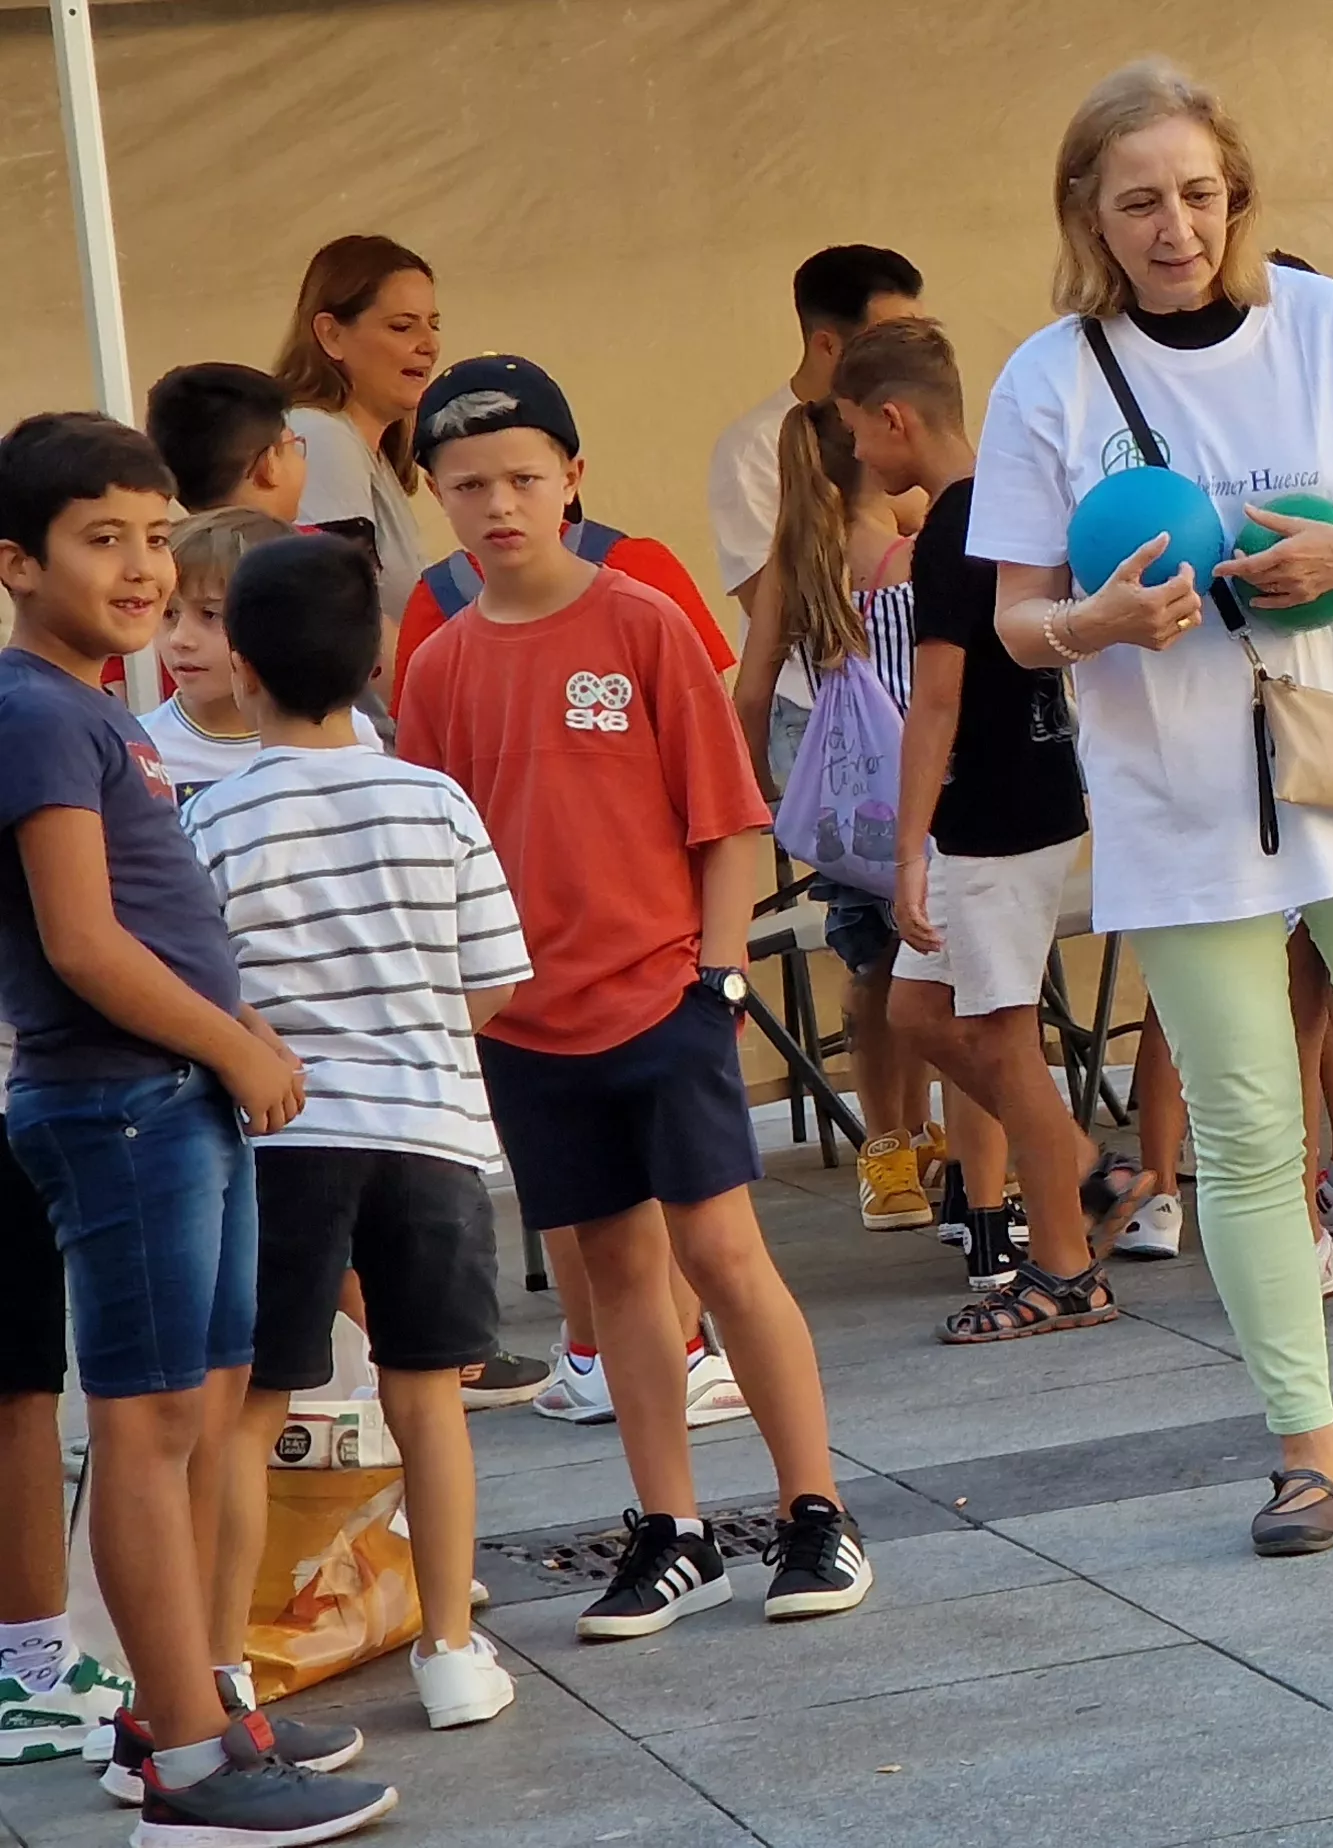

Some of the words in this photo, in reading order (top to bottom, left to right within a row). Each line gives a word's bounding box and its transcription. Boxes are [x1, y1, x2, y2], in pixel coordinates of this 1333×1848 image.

[1197, 474, 1247, 497] heimer
[1250, 467, 1319, 492] Huesca
[565, 708, 629, 732] SK8
